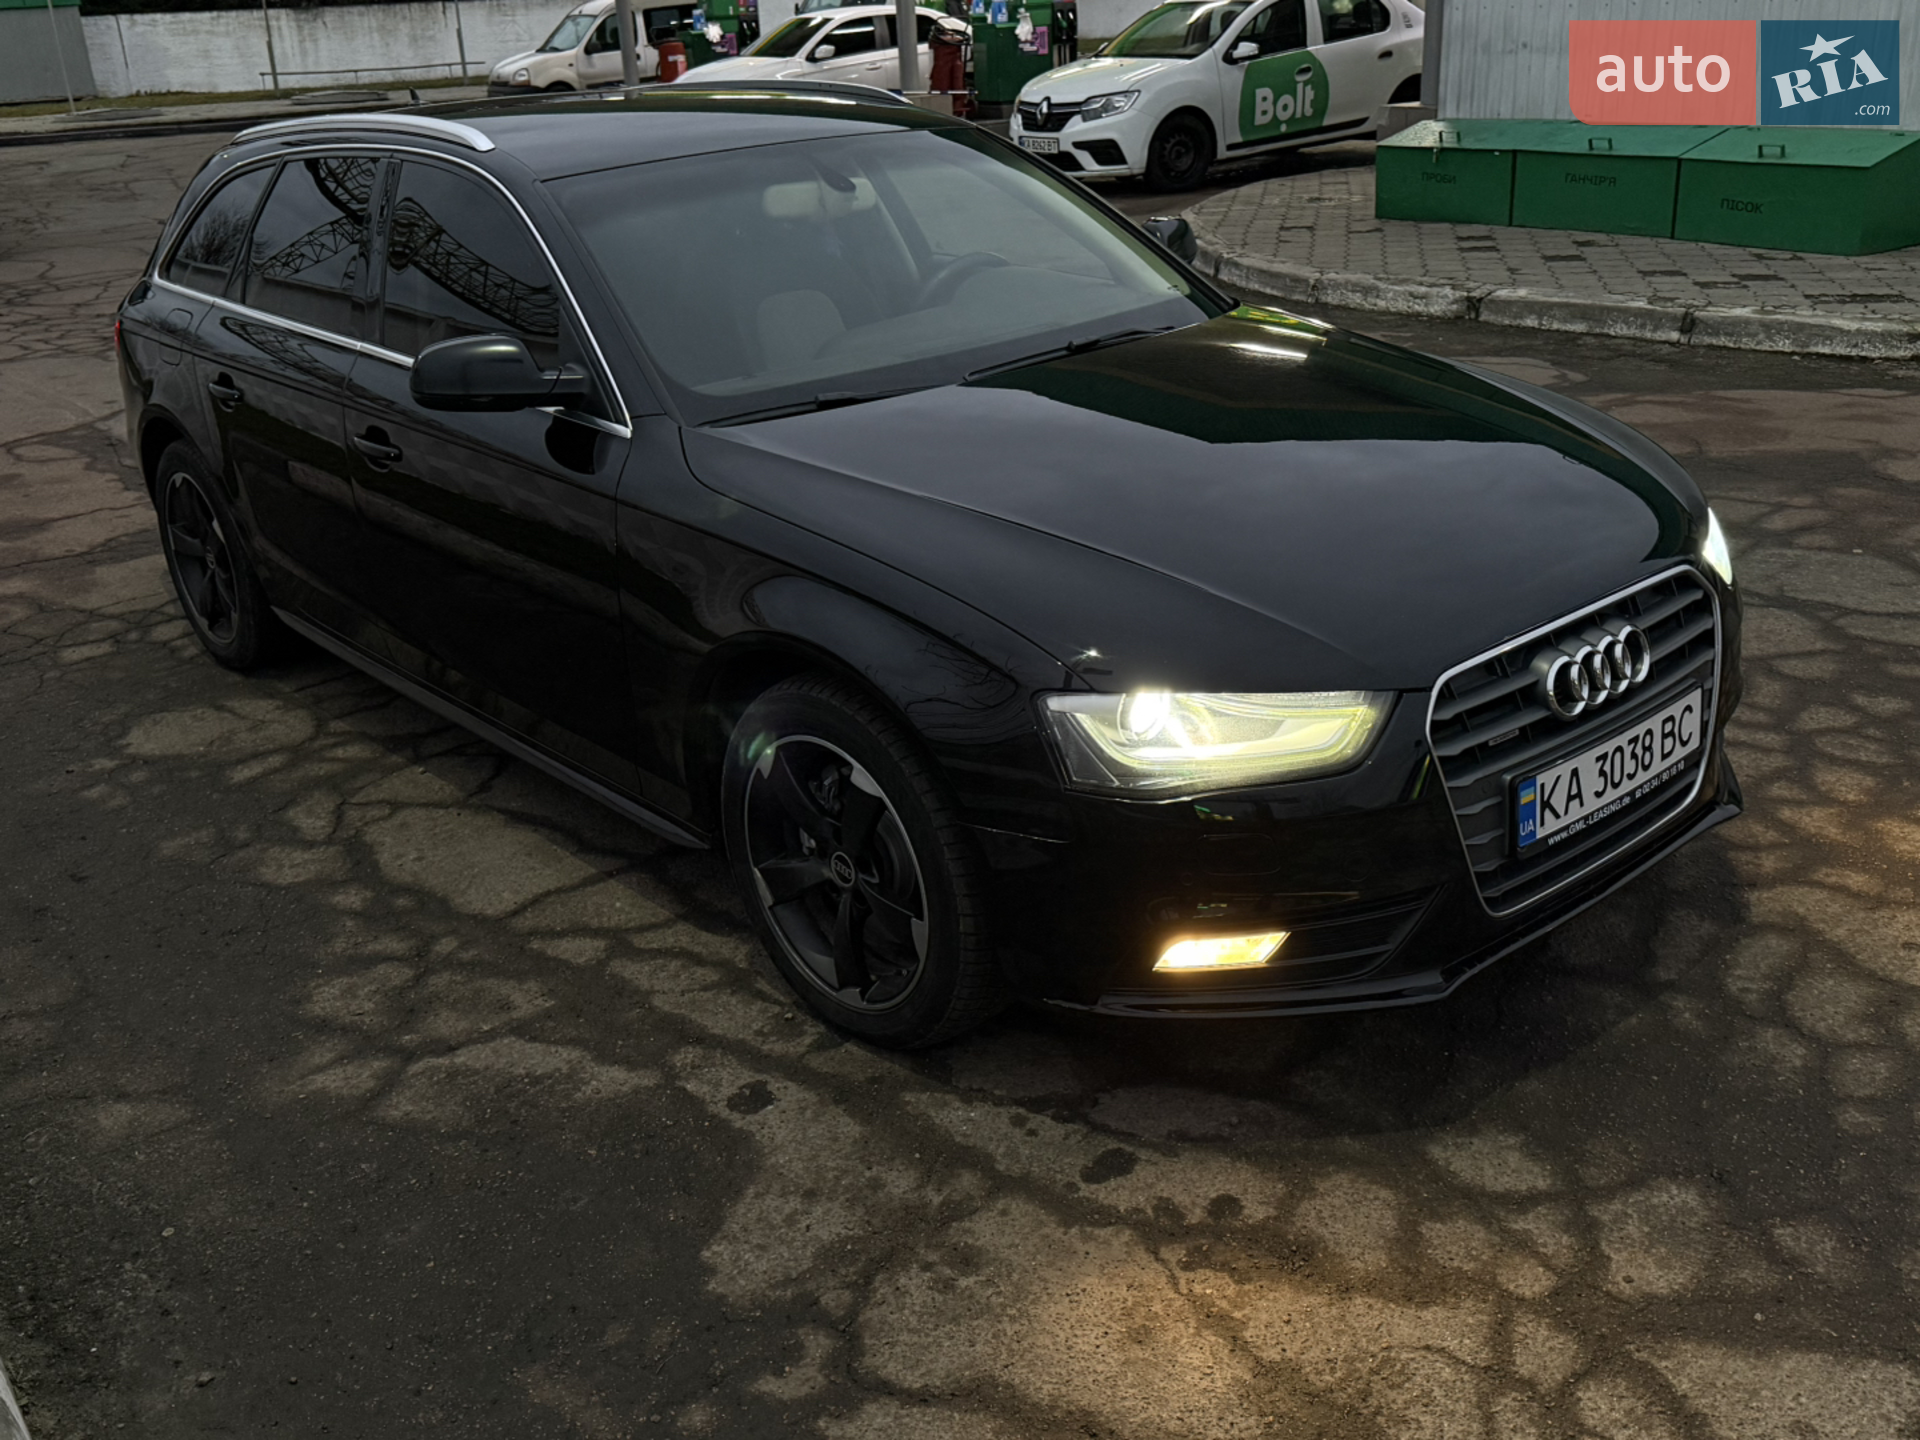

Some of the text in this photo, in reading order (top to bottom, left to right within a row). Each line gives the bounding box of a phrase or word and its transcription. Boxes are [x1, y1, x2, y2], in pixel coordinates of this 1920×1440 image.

[1254, 81, 1315, 128] Bolt
[1421, 171, 1457, 185] ПРОБИ
[1720, 198, 1765, 215] ПІСОК
[1539, 704, 1694, 828] KA 3038 BC
[1519, 819, 1536, 836] UA
